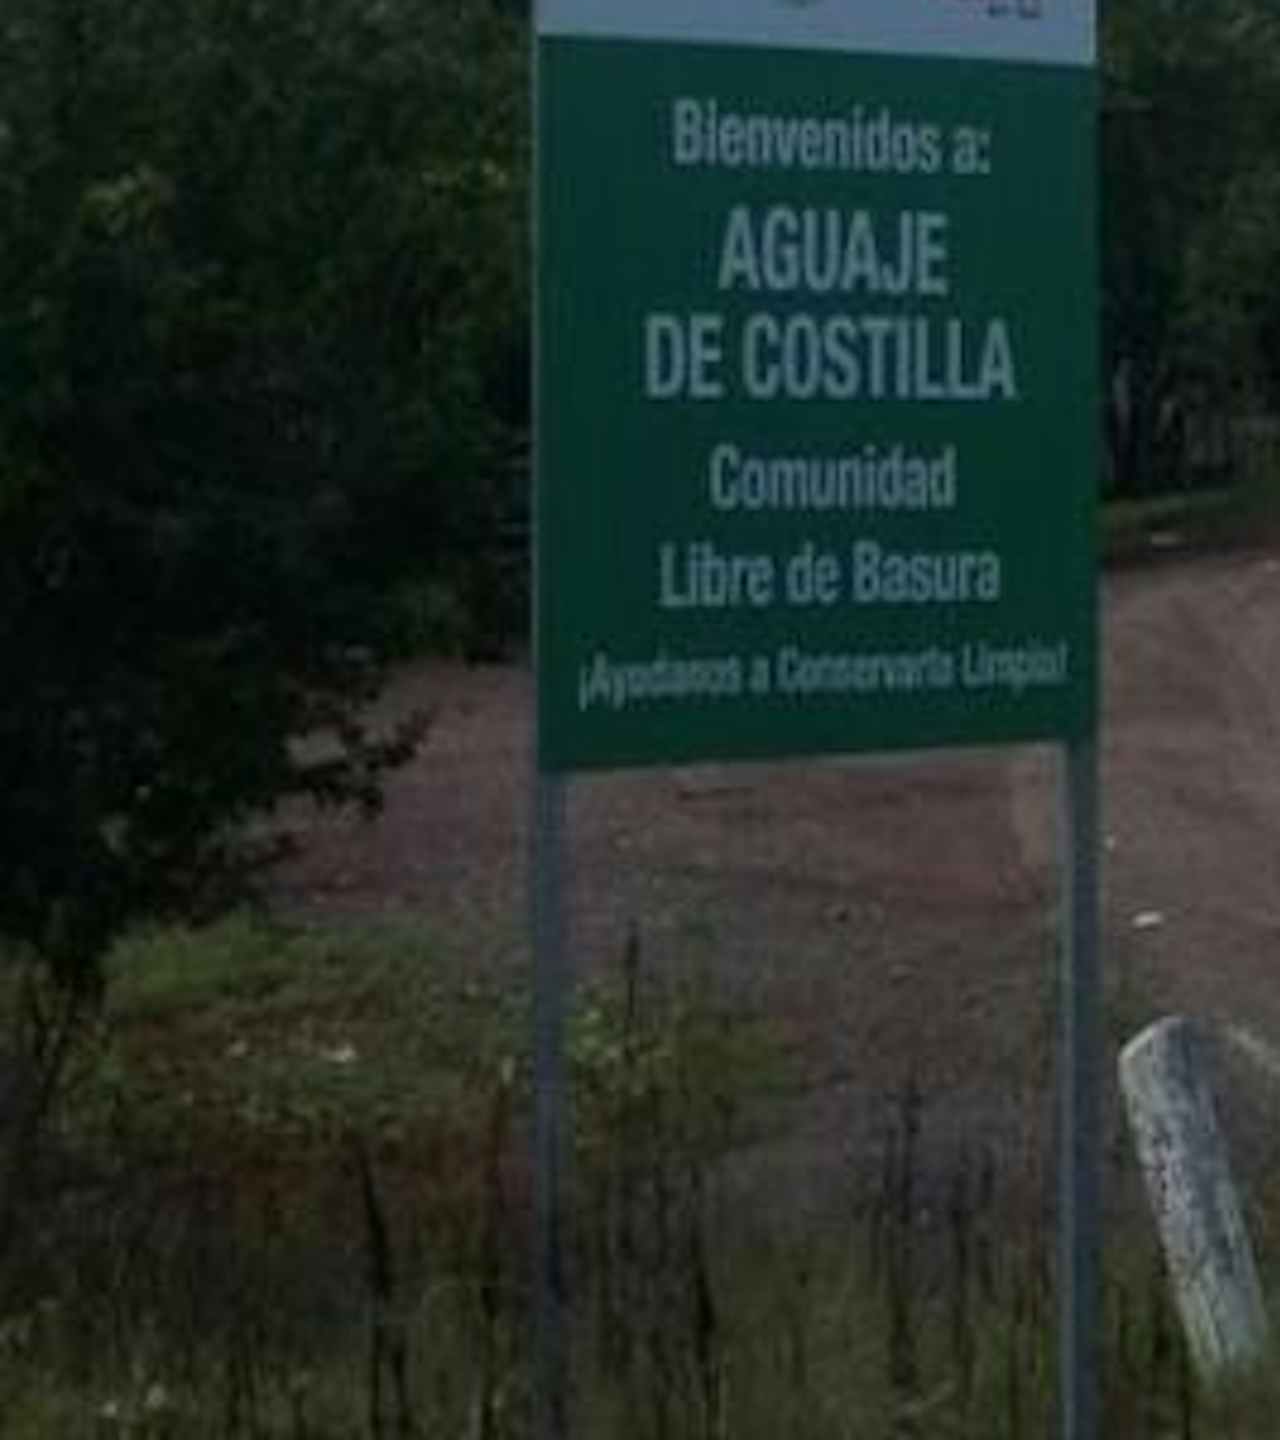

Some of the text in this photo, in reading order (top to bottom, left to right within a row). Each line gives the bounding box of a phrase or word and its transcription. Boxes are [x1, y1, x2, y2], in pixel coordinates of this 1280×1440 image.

[673, 97, 991, 175] Bienvenidos a:
[718, 203, 949, 296] AGUAJE
[644, 312, 1018, 400] DE COSTILLA
[709, 442, 957, 510] Comunidad
[659, 539, 1002, 608] Libre de Basura
